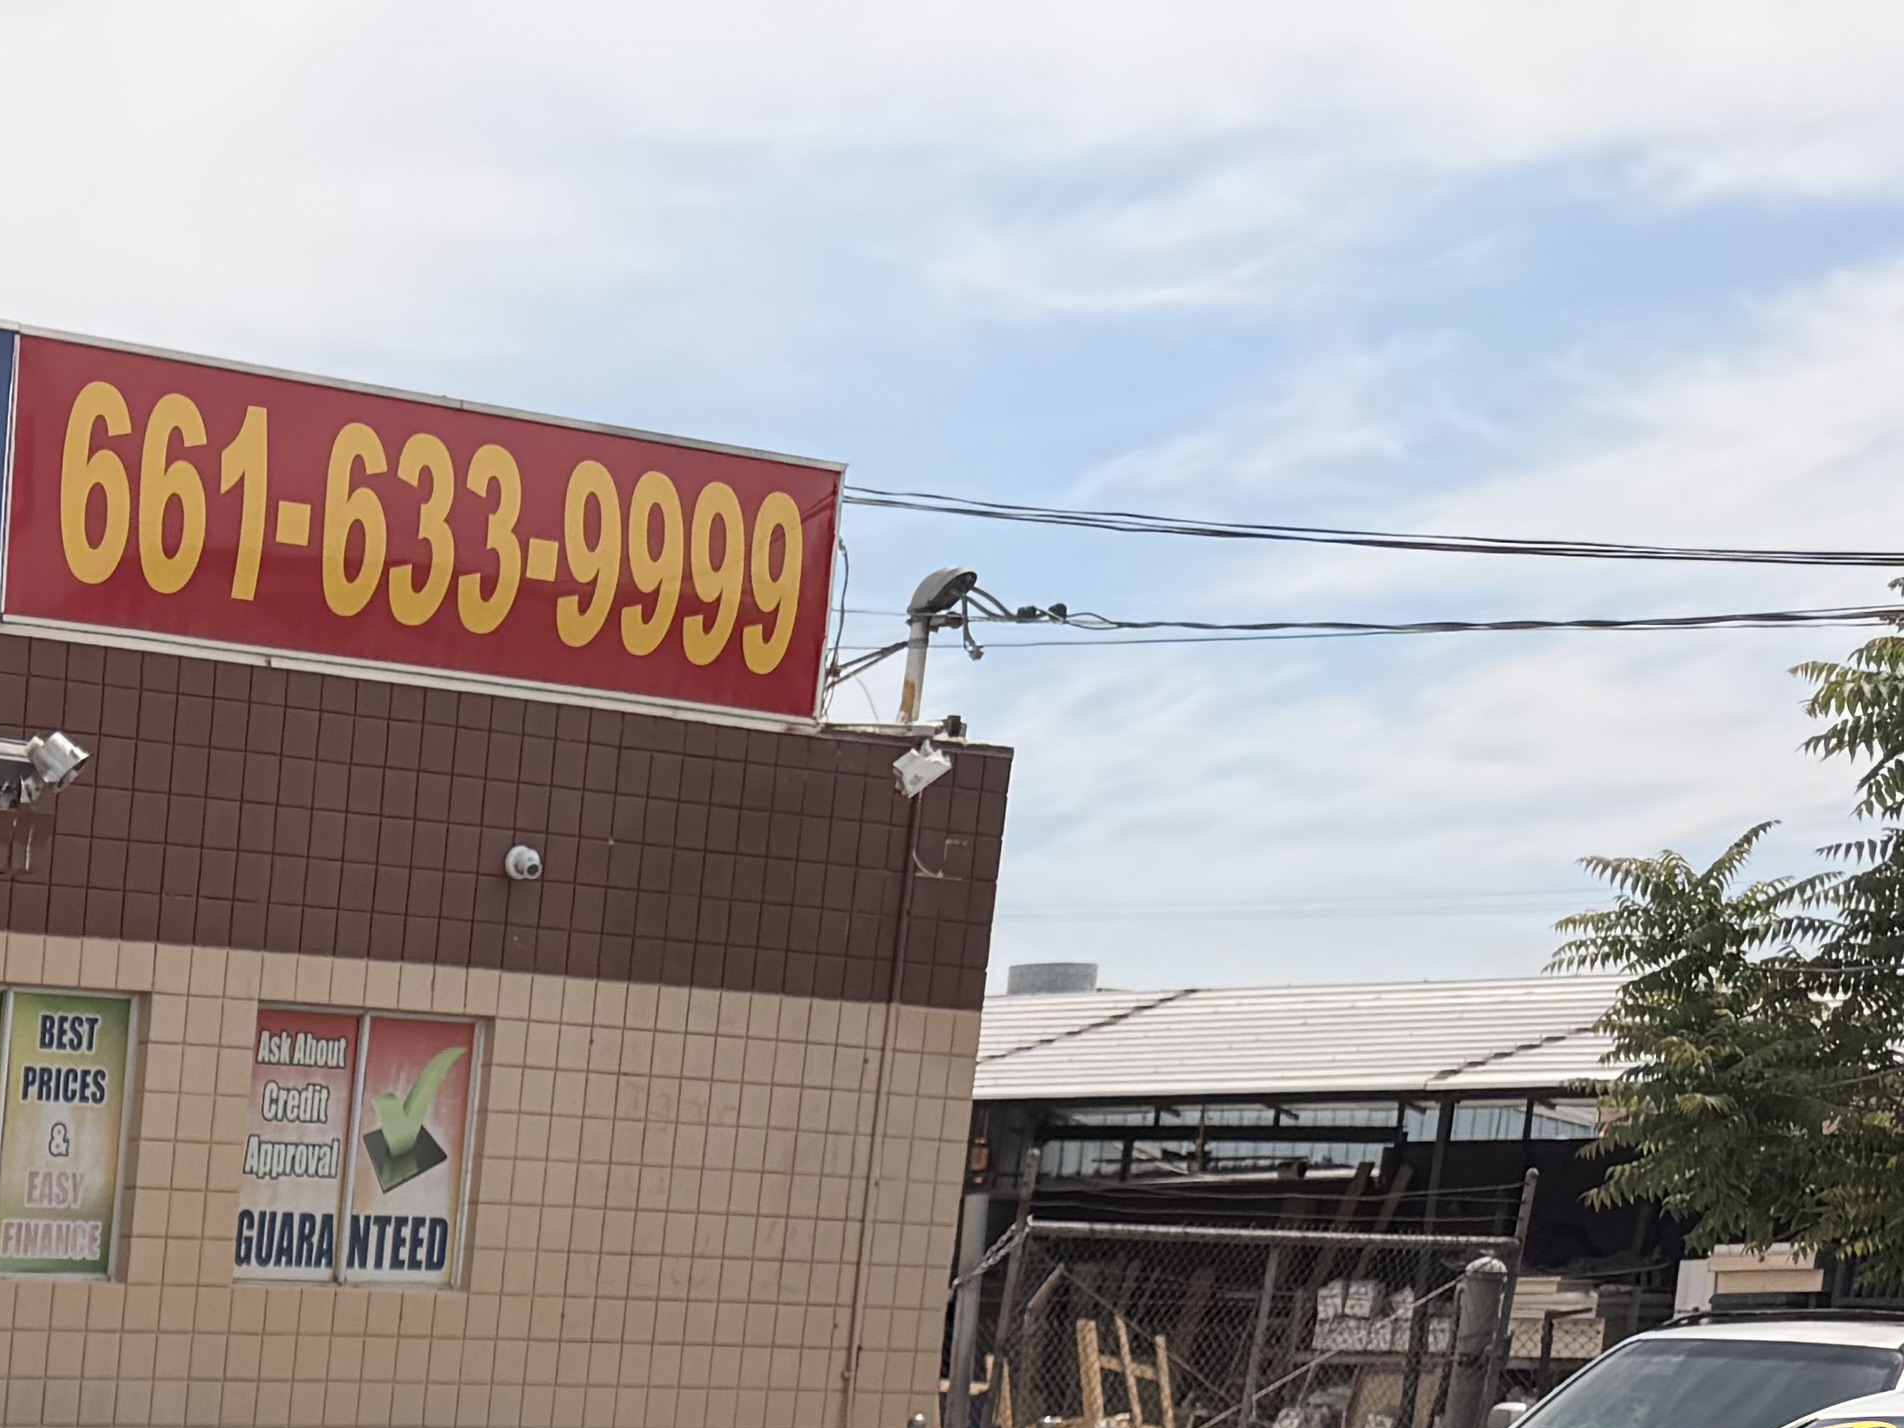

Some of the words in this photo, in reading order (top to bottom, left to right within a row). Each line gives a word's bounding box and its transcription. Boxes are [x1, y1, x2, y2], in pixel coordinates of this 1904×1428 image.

[59, 381, 803, 675] 661-633-9999
[39, 1014, 99, 1051] BEST
[257, 1030, 292, 1064] Ask
[293, 1032, 346, 1069] About
[21, 1066, 107, 1105] PRICES
[262, 1080, 329, 1124] Credit
[48, 1122, 70, 1158] &
[243, 1134, 341, 1180] Approval
[26, 1171, 85, 1209] EASY
[0, 1219, 102, 1260] FINANCE
[234, 1209, 449, 1271] GUARANTEED
